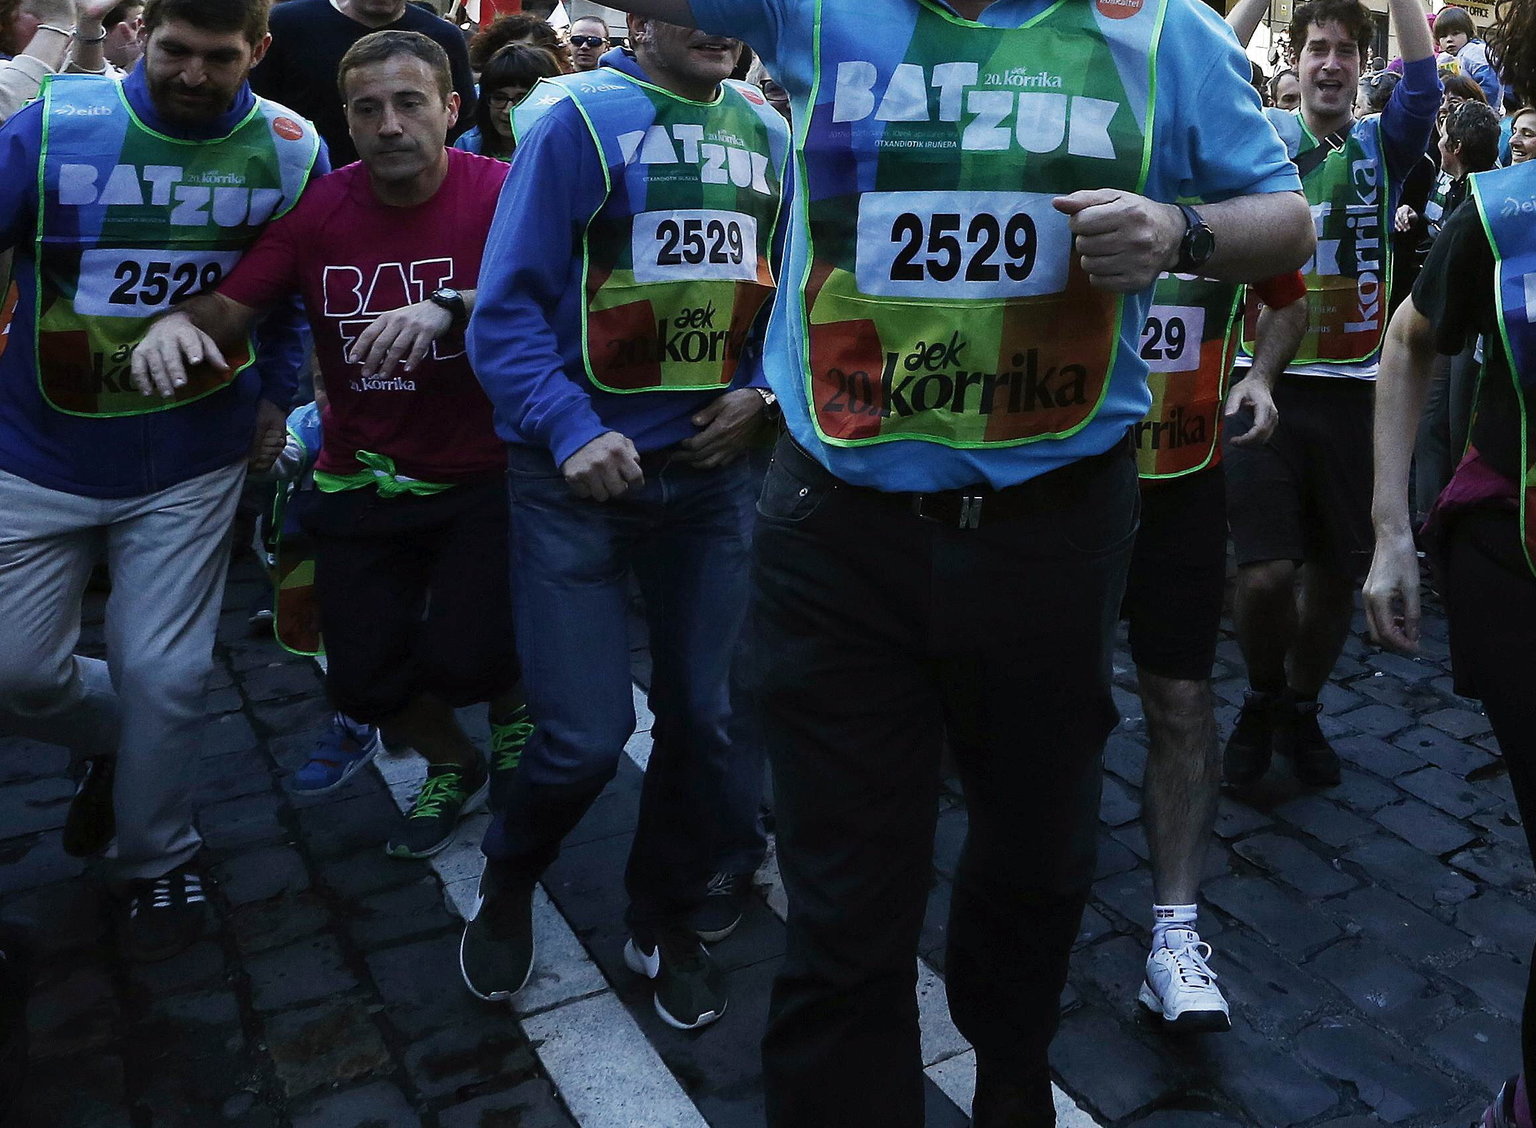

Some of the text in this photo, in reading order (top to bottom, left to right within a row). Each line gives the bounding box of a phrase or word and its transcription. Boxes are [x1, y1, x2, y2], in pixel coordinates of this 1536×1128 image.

[832, 61, 979, 122] BAT
[961, 90, 1120, 160] ZUK
[58, 163, 183, 206] BAT
[656, 219, 743, 266] 2529
[890, 213, 1037, 282] 2529
[323, 258, 453, 317] BAT
[674, 299, 716, 329] aek
[904, 330, 967, 372] aek
